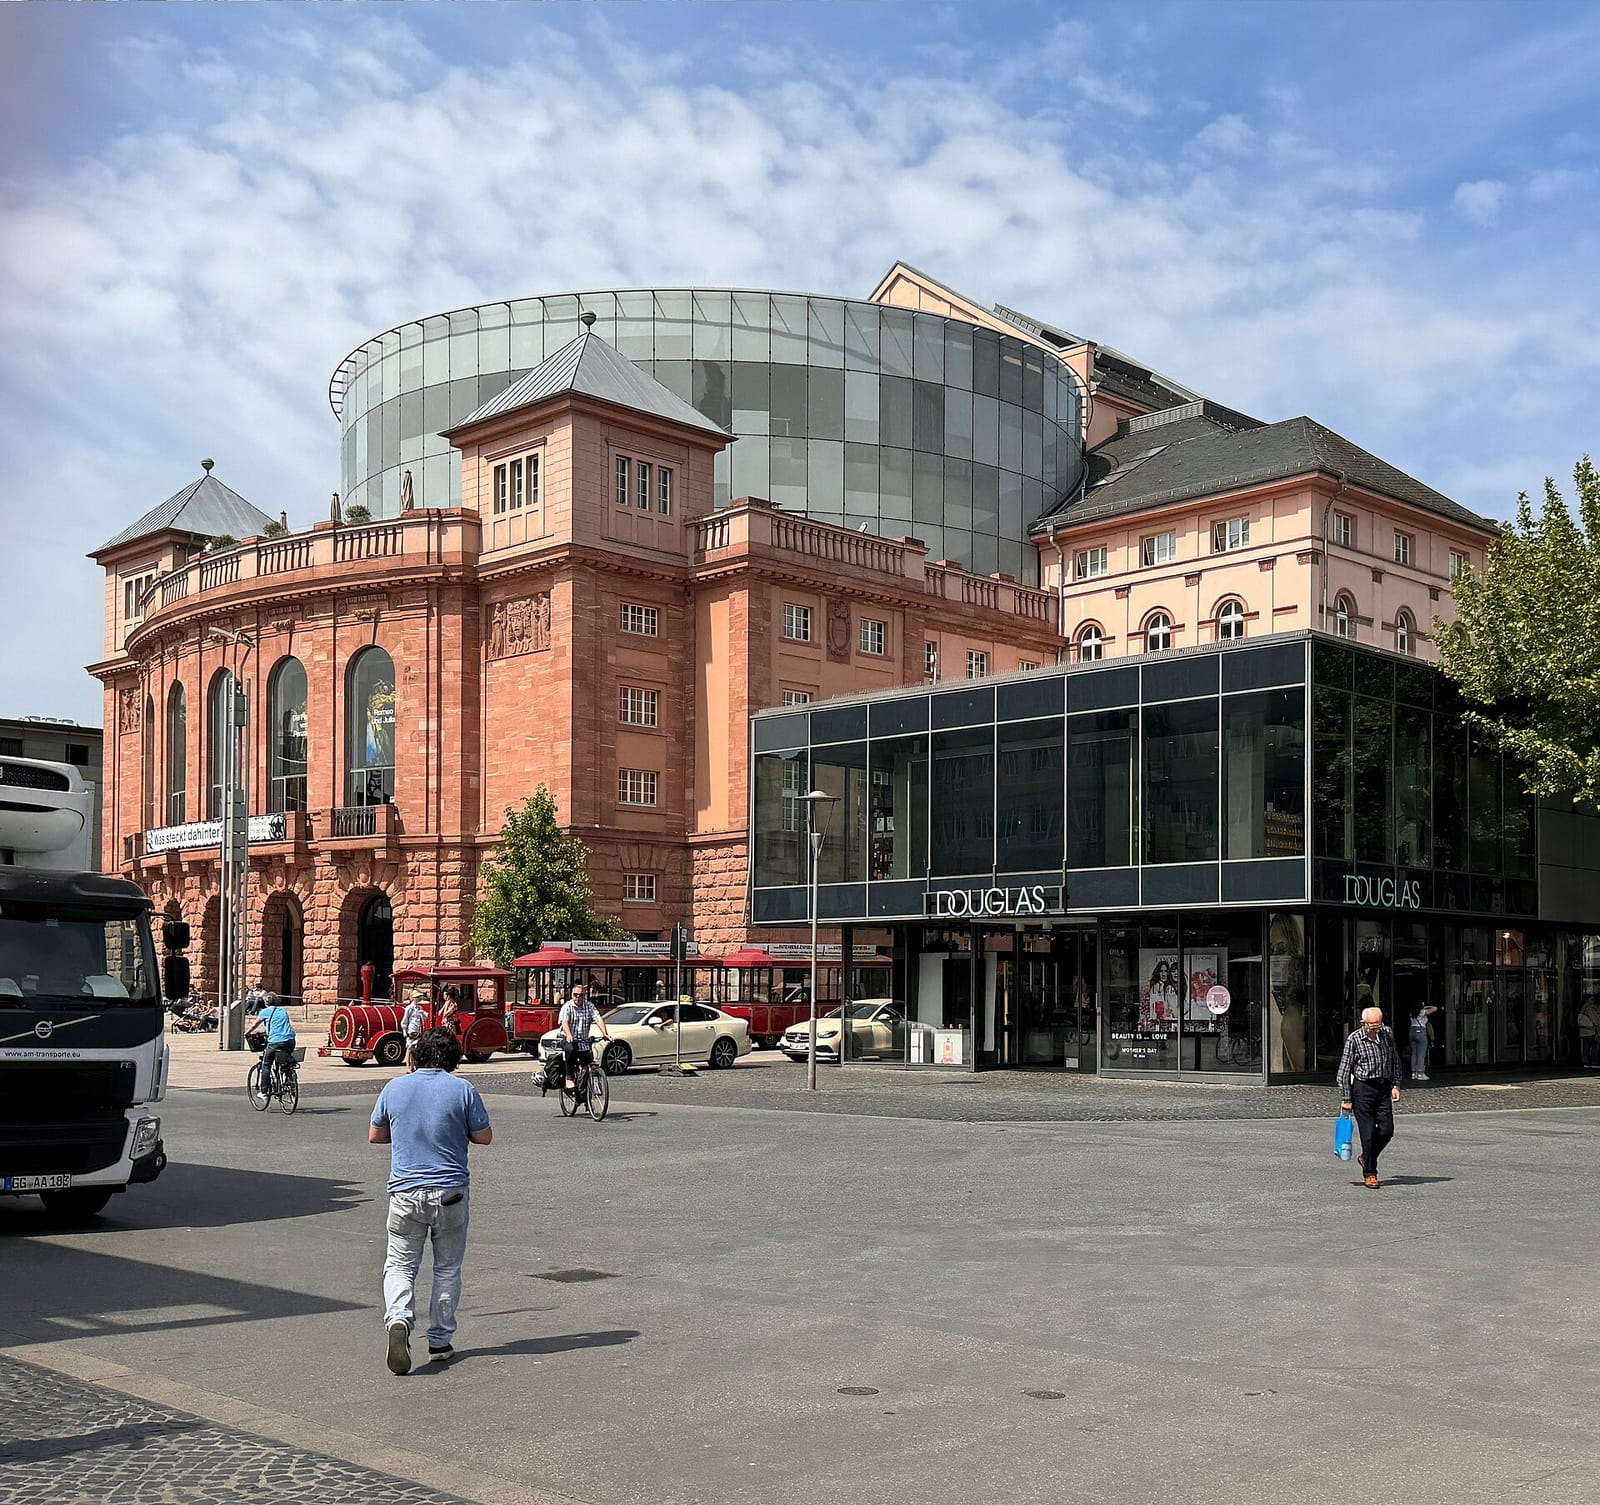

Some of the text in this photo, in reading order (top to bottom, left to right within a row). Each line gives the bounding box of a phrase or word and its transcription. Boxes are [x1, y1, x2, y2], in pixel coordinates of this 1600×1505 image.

[154, 832, 165, 845] Was
[166, 830, 187, 843] steckt
[1342, 875, 1420, 909] DOUGLAS
[937, 885, 1045, 916] DOUGLAS
[4, 1050, 81, 1059] www.am-transporte.eu
[12, 1177, 27, 1189] GG
[34, 1176, 48, 1188] AA
